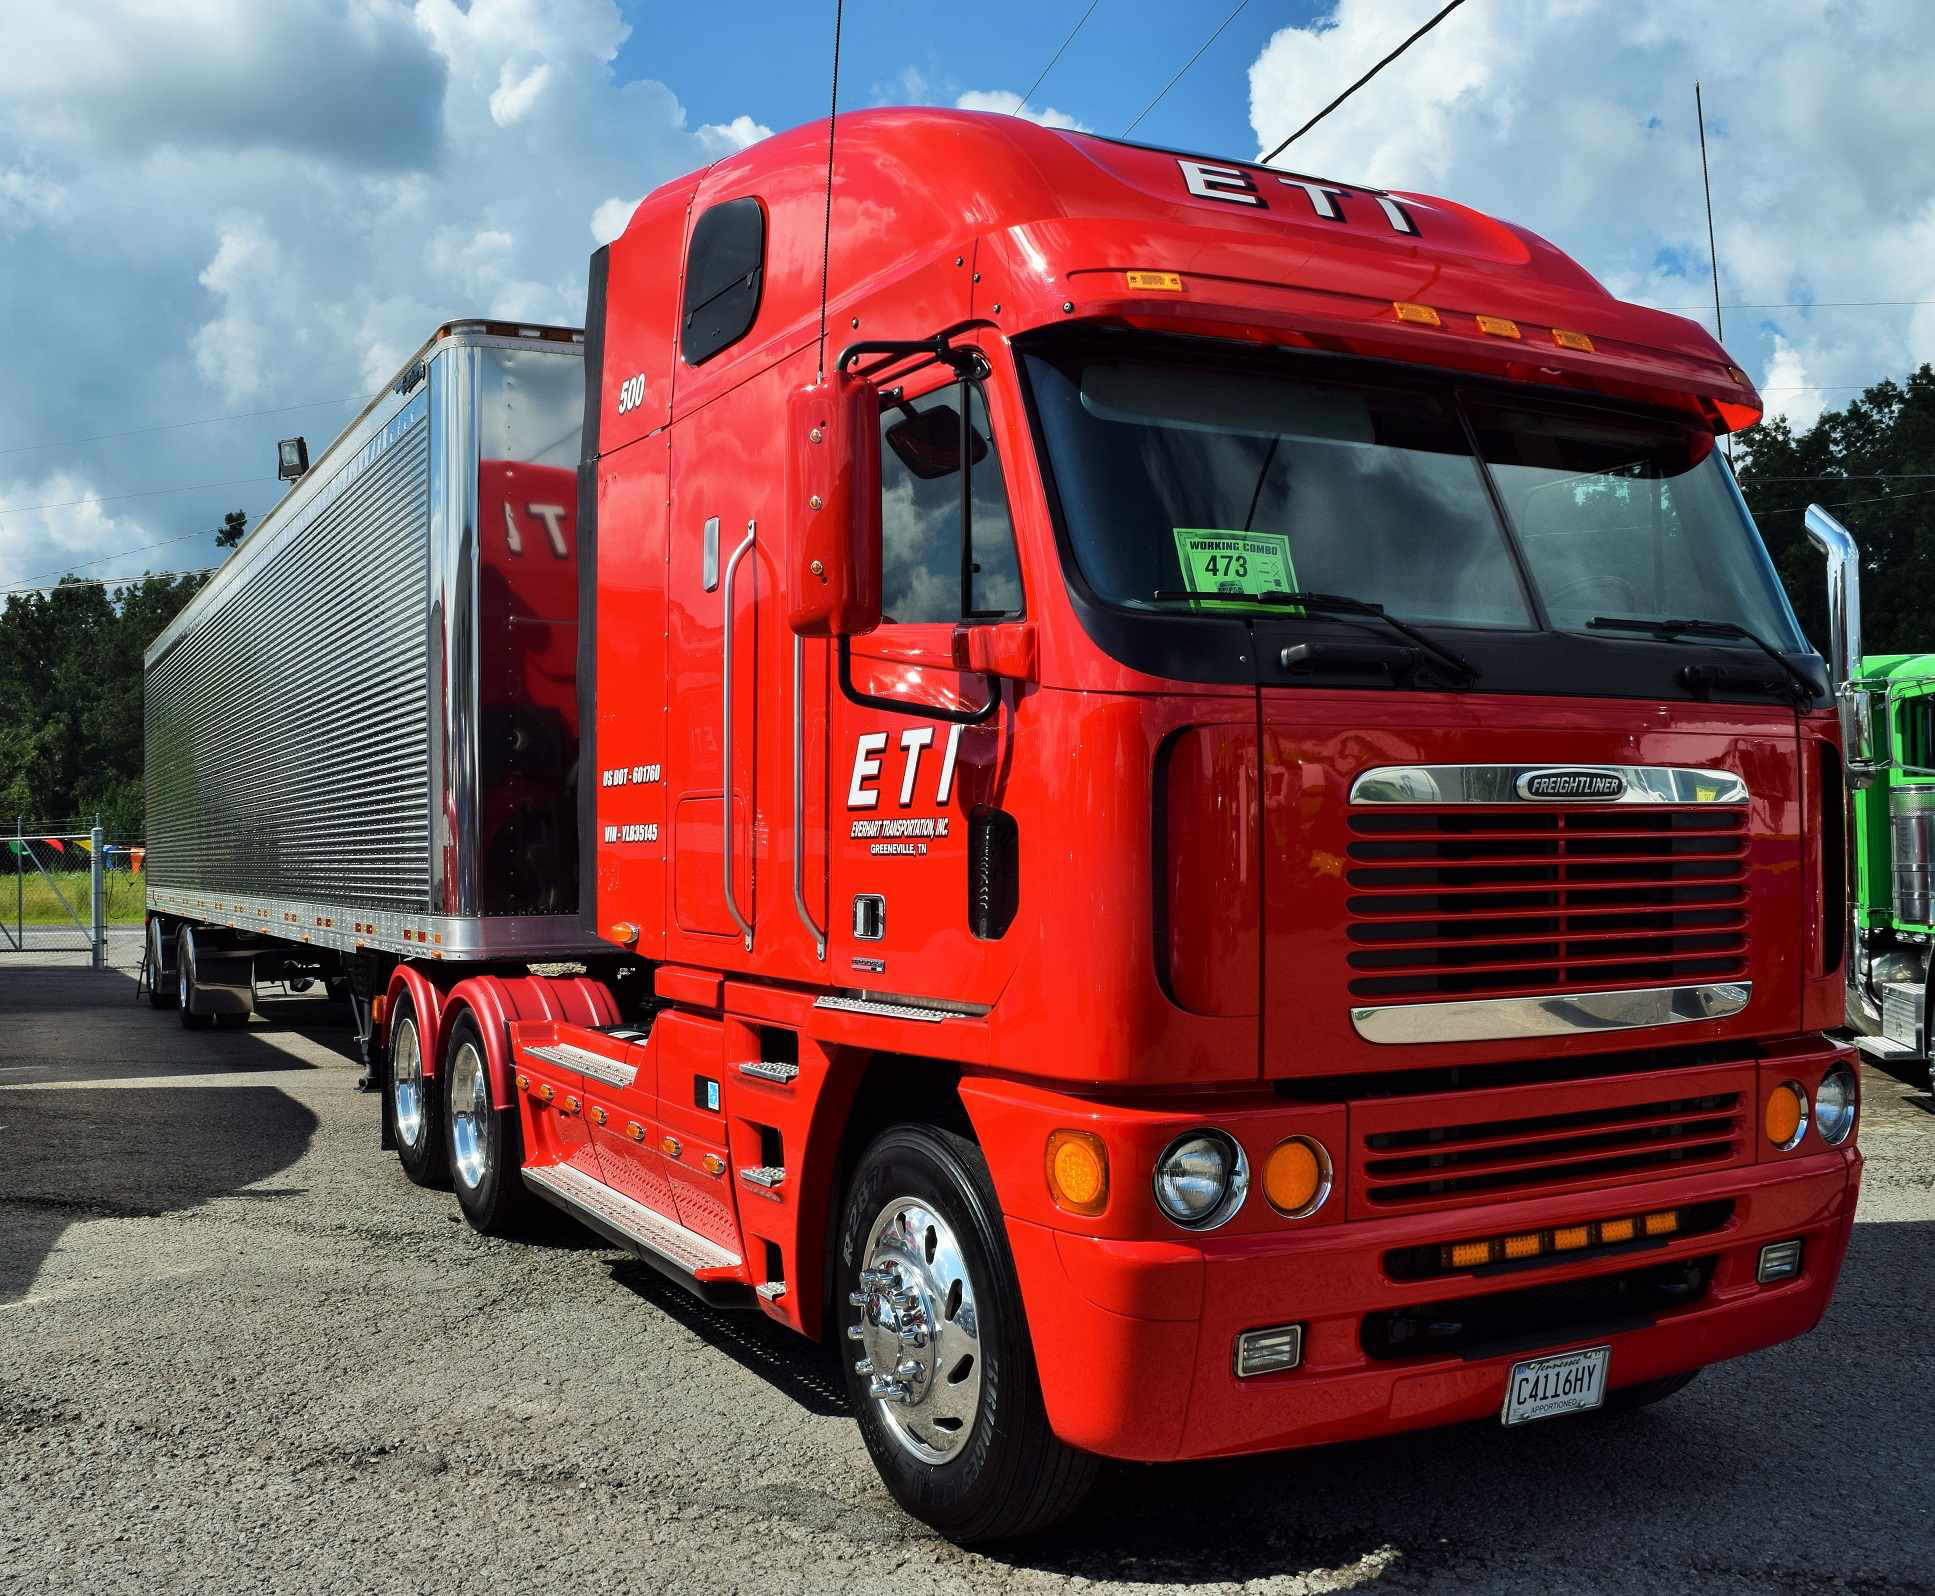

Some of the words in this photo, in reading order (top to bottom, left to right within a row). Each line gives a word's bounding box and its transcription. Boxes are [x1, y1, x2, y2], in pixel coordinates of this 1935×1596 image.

[618, 373, 646, 415] 500
[1189, 540, 1240, 551] WORKING
[1243, 543, 1278, 556] COMBO
[1204, 555, 1248, 578] 473
[632, 763, 661, 784] 601760
[847, 724, 963, 810] ETI
[1531, 776, 1619, 794] FREIGHTLINER
[604, 825, 618, 843] VIN
[850, 820, 882, 837] EVERHART
[881, 818, 935, 839] TRANSPORTATION,
[870, 843, 916, 856] GREENEVILLE,
[917, 843, 928, 854] TN
[1516, 1364, 1597, 1406] C4116HY
[1530, 1398, 1578, 1414] APPORTIONED
